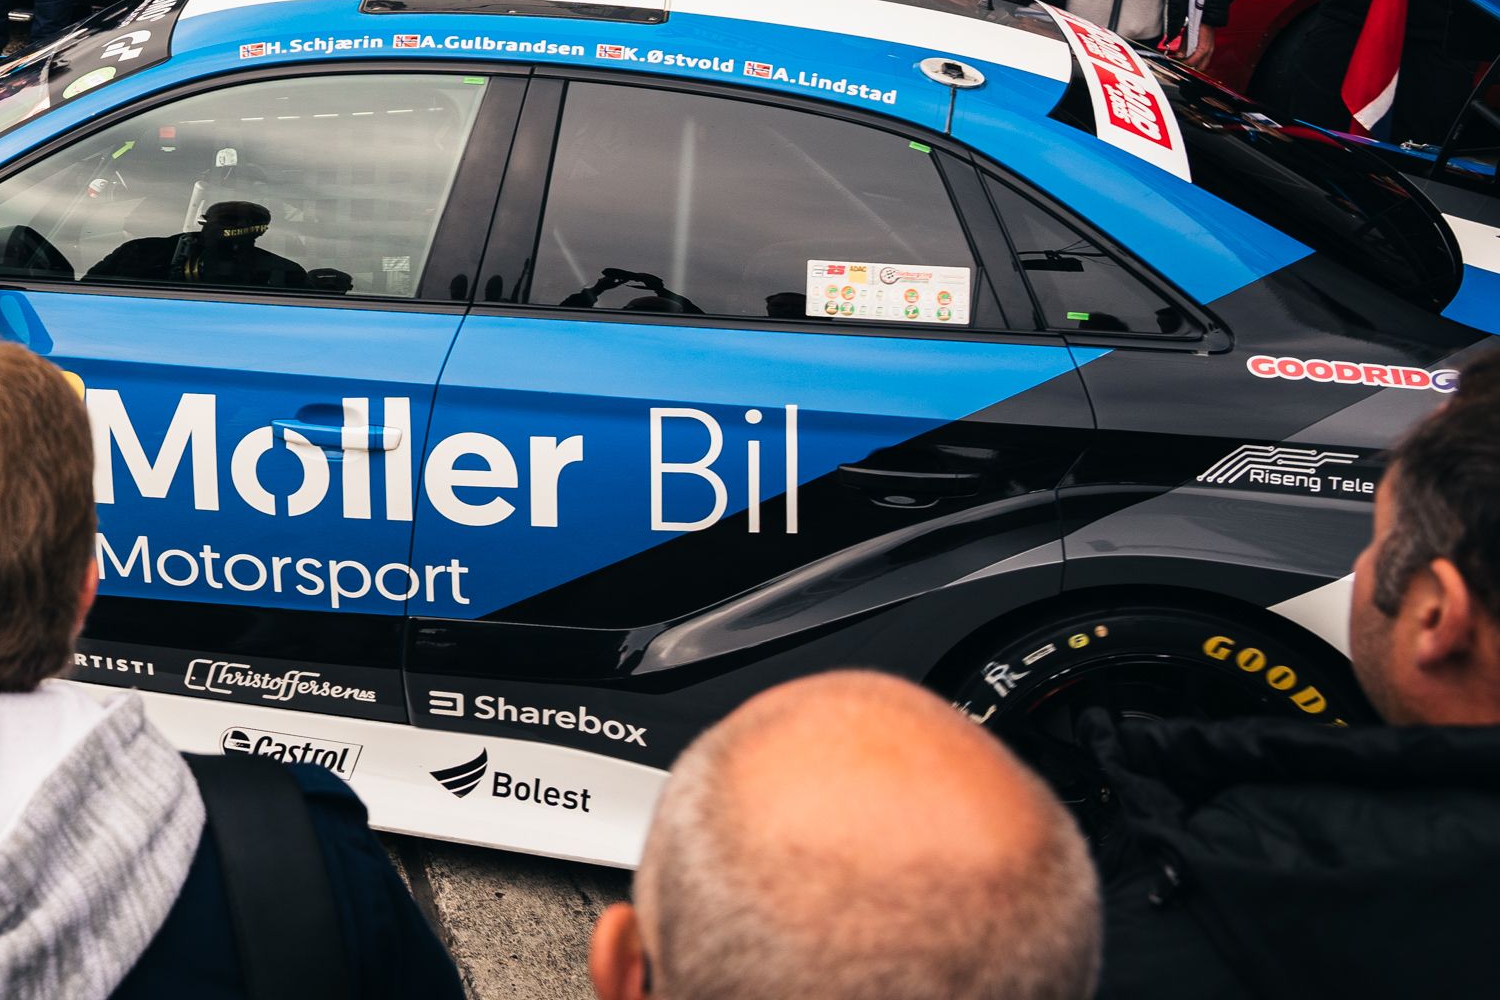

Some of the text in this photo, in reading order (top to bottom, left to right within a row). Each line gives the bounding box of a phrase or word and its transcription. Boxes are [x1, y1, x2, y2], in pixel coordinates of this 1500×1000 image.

[266, 35, 898, 105] H.Schjærin A.Gulbrandsen K.Østvold A.Lindstad
[649, 403, 800, 535] Bil
[1250, 469, 1321, 492] Riseng
[97, 532, 471, 610] Motorsport
[1202, 635, 1329, 715] GOOD
[473, 694, 647, 748] Sharebox
[254, 735, 350, 774] Castrol
[490, 772, 592, 814] Bolest
